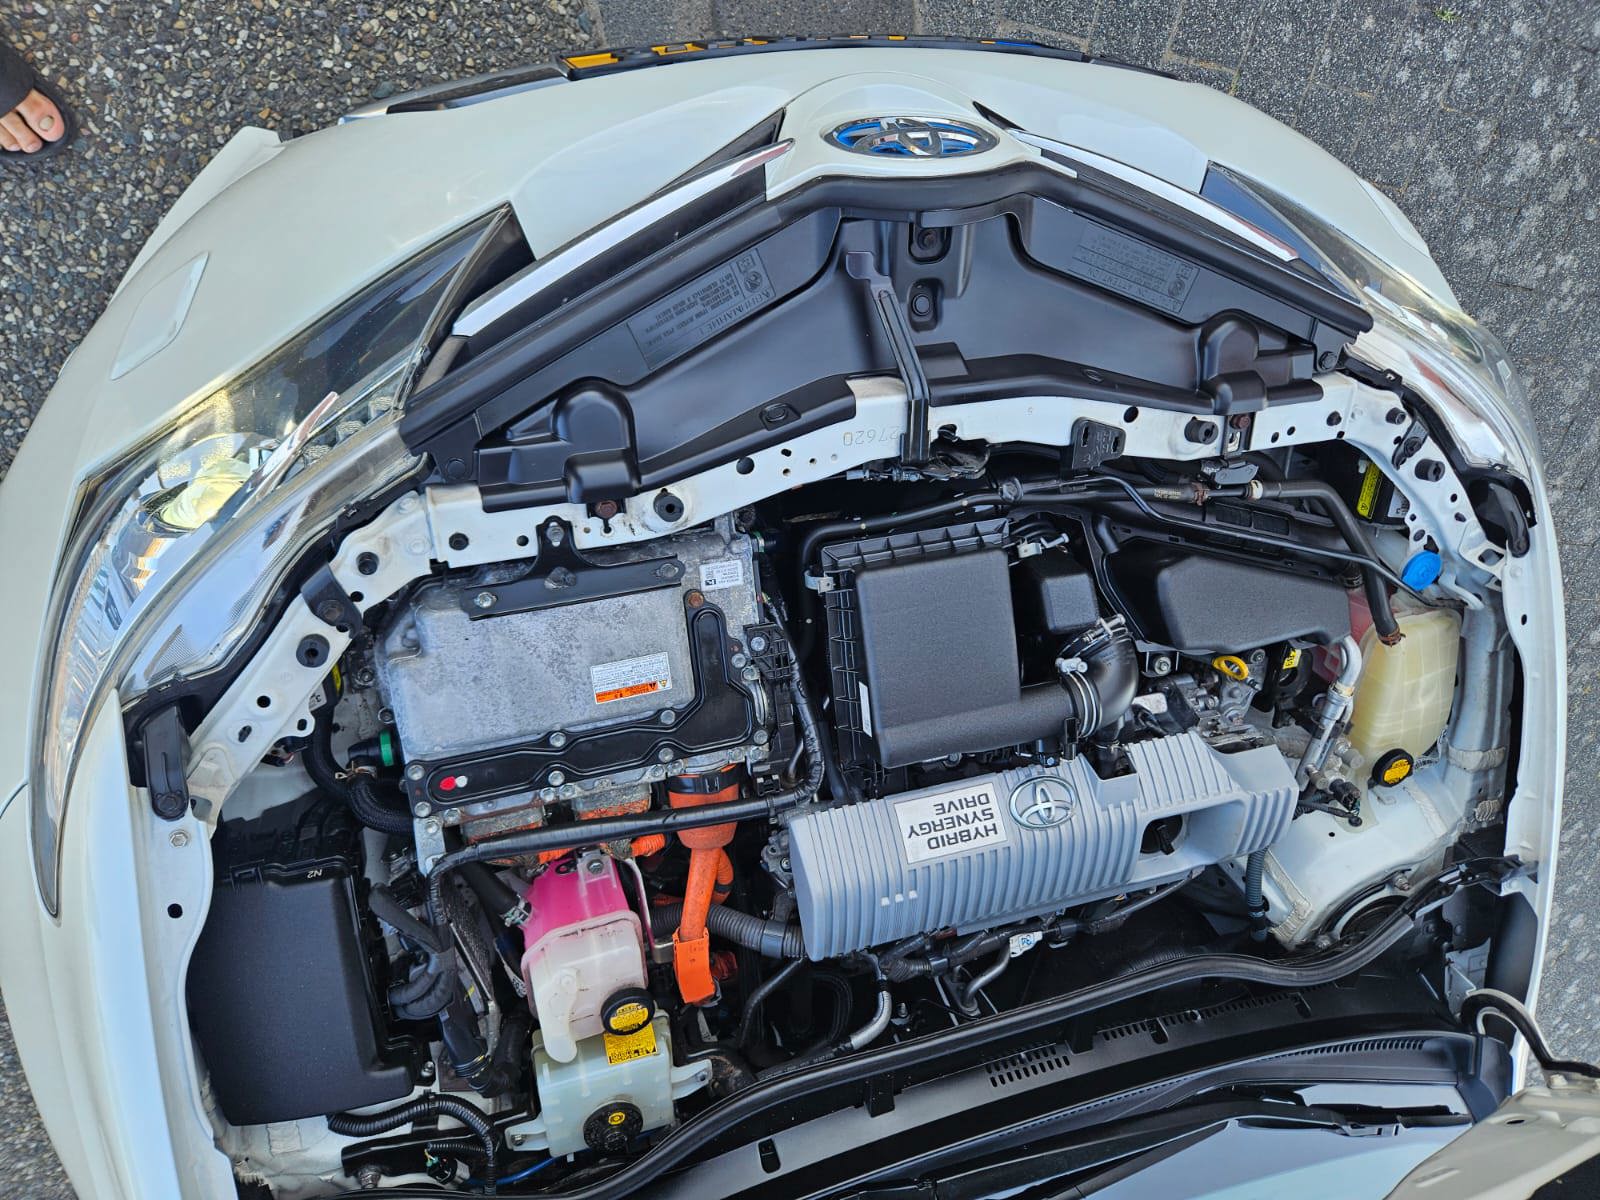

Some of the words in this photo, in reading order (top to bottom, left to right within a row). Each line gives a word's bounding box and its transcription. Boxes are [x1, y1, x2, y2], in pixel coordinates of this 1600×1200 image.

[933, 792, 990, 816] DRIVE
[907, 807, 994, 839] SYNERGY
[927, 823, 998, 850] HYBRID
[306, 868, 323, 879] N2
